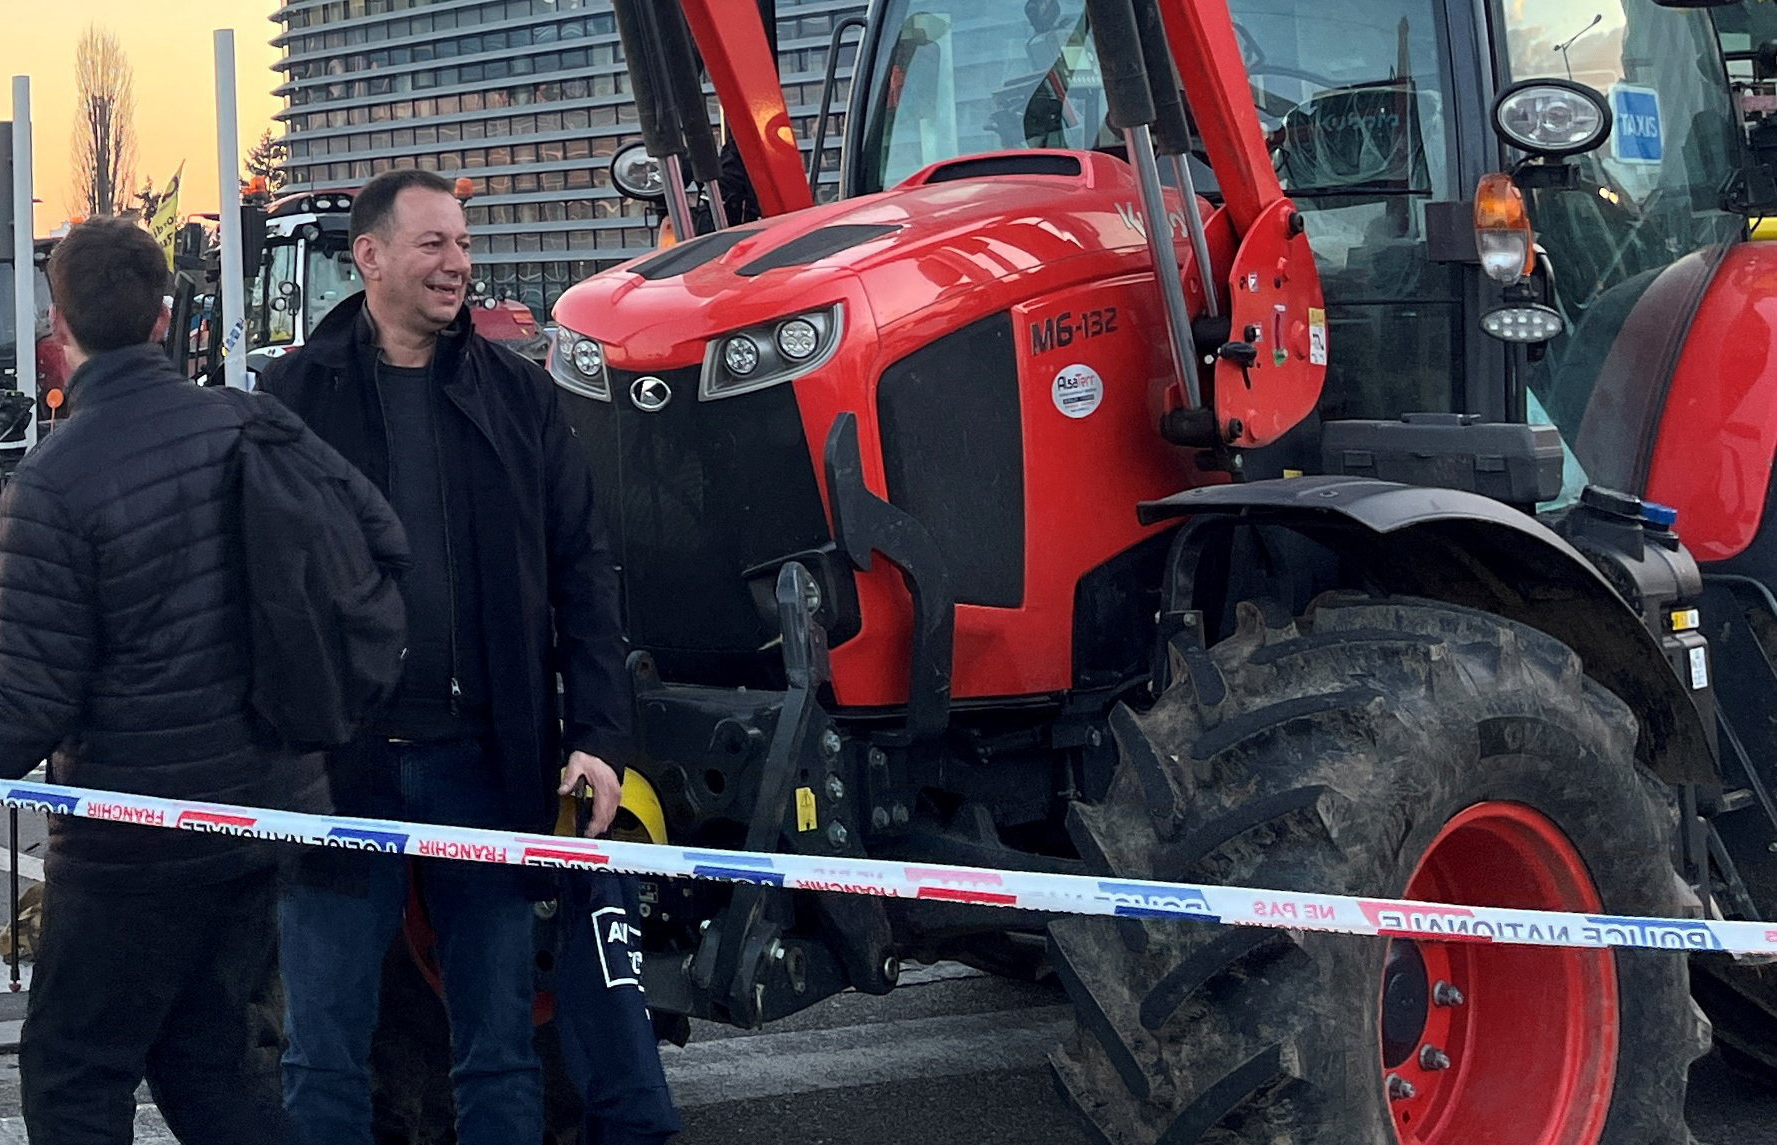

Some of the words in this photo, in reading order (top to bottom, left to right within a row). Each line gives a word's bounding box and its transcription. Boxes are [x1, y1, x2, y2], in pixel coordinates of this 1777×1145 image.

[1618, 113, 1658, 138] TAXIS
[1030, 306, 1118, 356] M6-132
[87, 801, 165, 826] FRANCHIR
[419, 839, 507, 864] FRANCHIR
